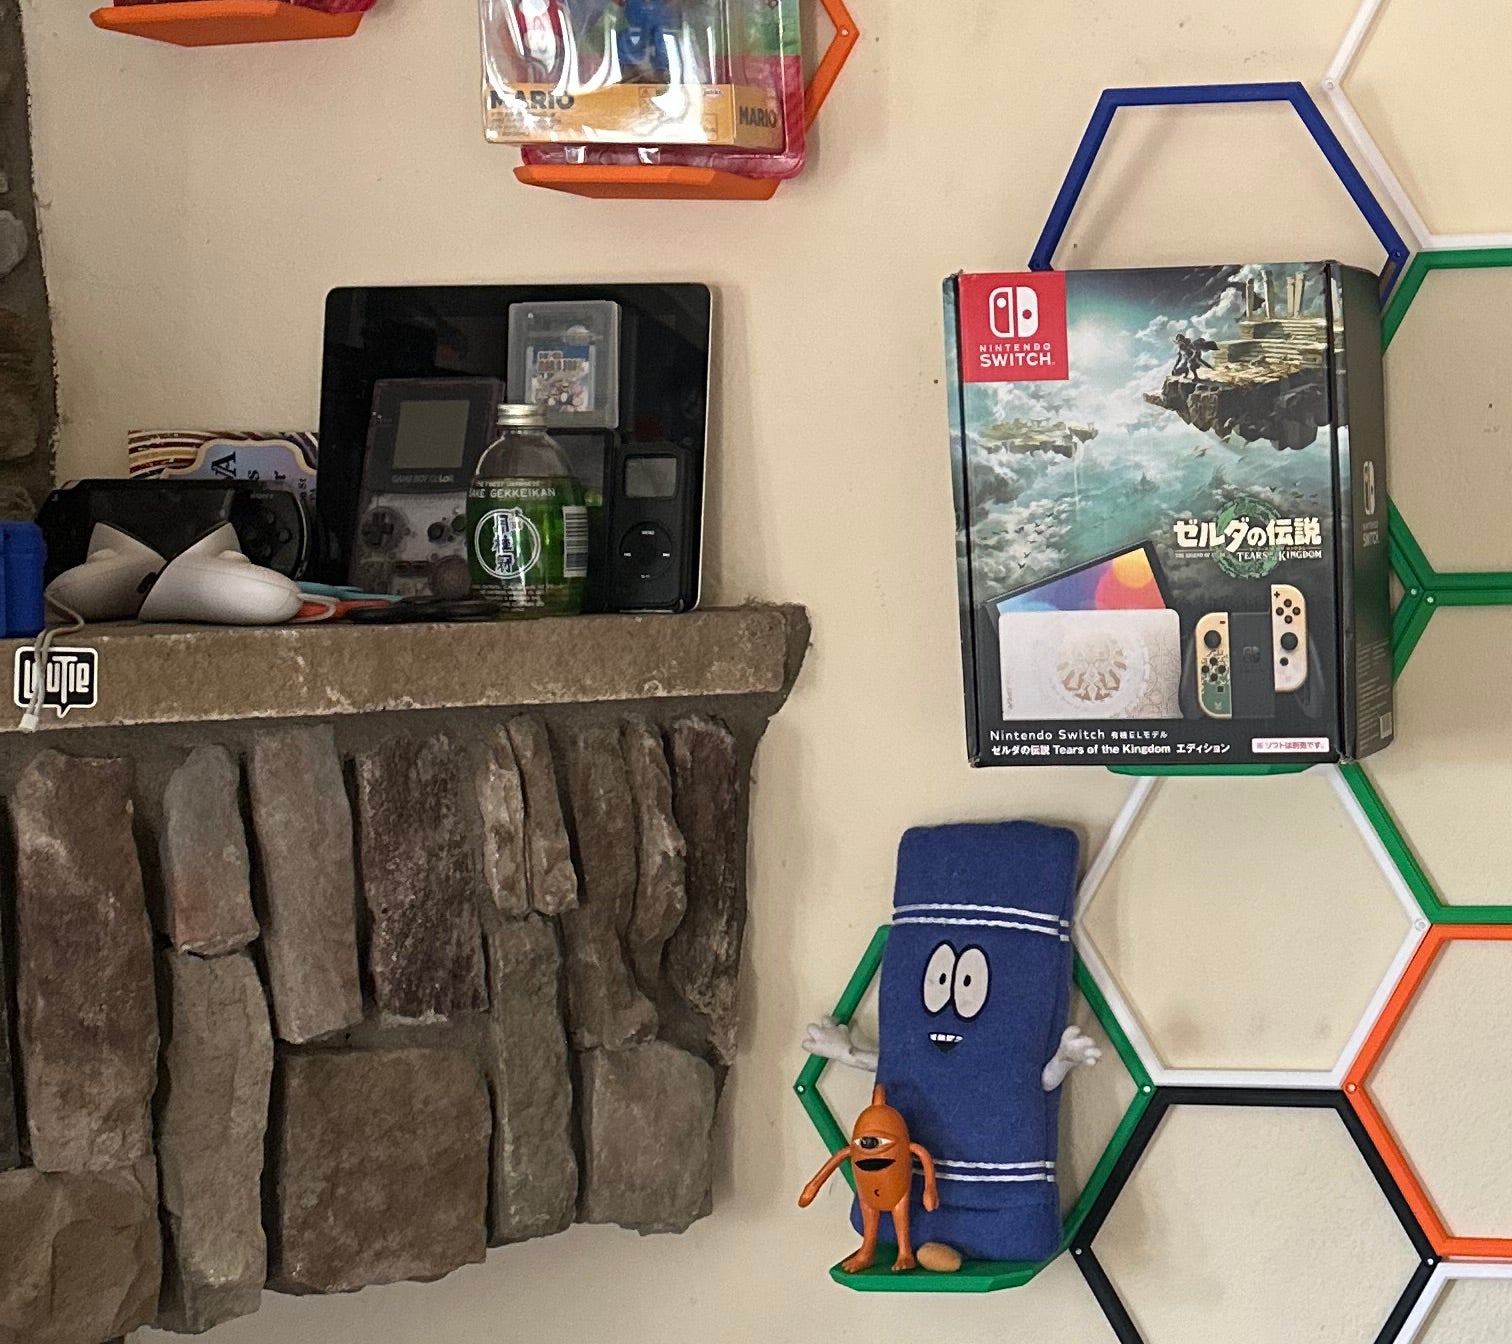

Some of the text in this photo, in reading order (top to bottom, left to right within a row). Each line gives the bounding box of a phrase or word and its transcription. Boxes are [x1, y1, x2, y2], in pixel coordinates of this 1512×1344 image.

[739, 106, 777, 128] MARIO
[979, 343, 1051, 352] NINTENDO
[980, 352, 1052, 367] SWITCH
[490, 488, 555, 498] GEKKEIKAN
[1173, 517, 1322, 552] ゼルダの伝説
[1237, 551, 1268, 562] TEARS
[1279, 550, 1323, 561] KINGDOM
[990, 730, 1053, 741] Nintendo
[1058, 729, 1105, 740] Switch
[991, 743, 1230, 756] ゼルダの伝説 Tears of the Kingdom エディション
